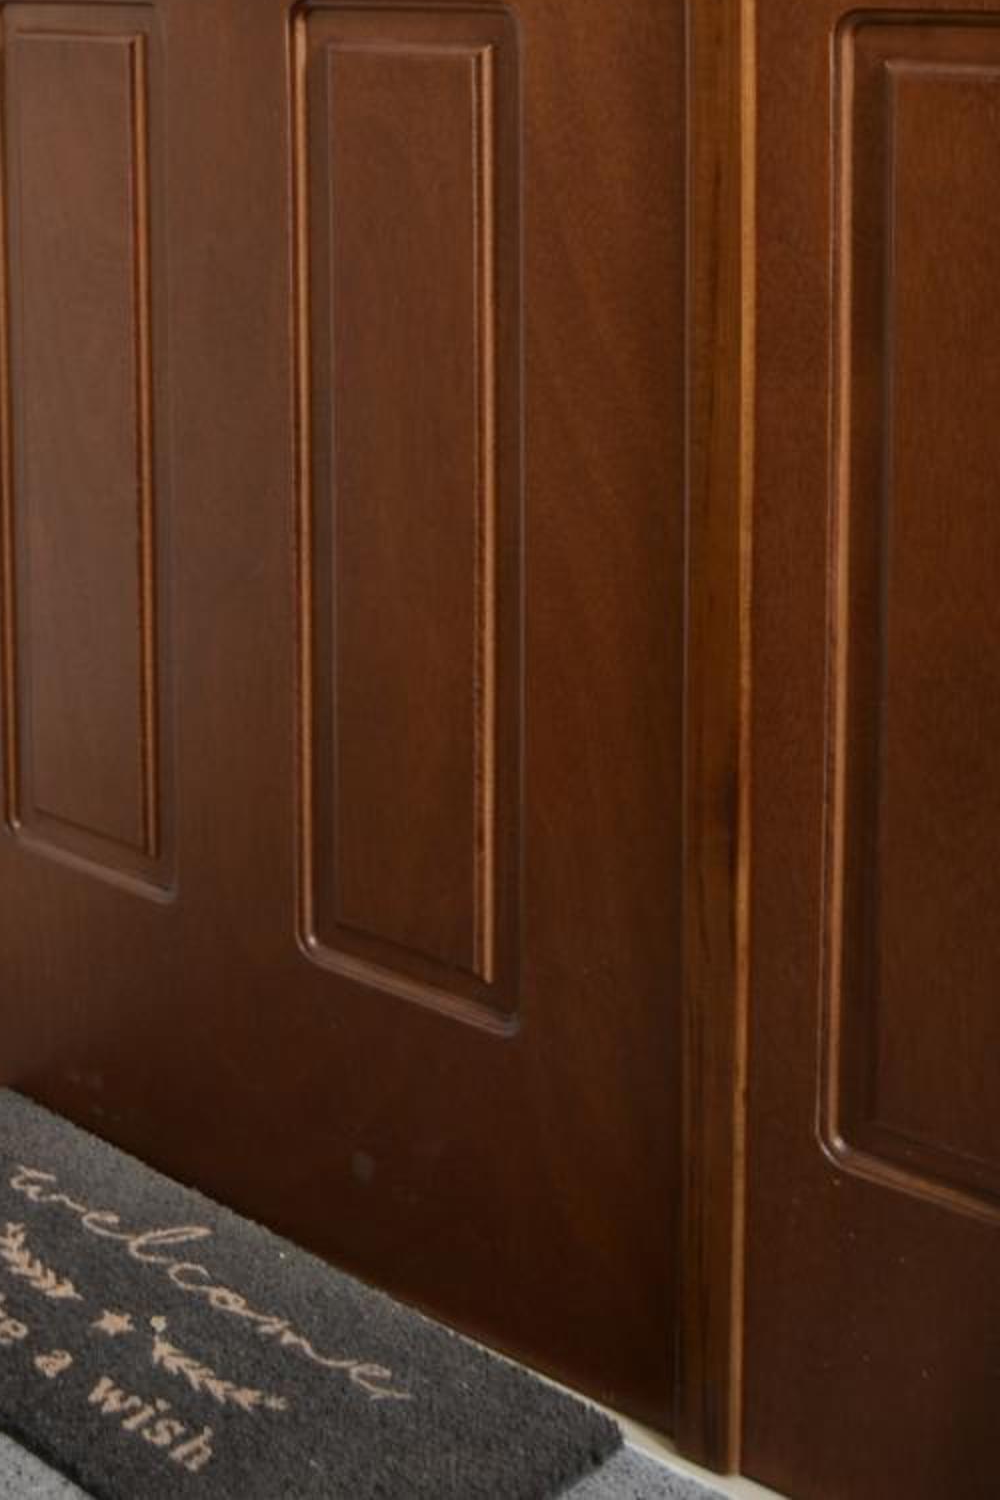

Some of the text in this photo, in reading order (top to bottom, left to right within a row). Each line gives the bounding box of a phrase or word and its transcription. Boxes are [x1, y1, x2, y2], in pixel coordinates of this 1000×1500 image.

[11, 1165, 412, 1400] welcome
[34, 1348, 73, 1378] a
[87, 1376, 215, 1472] wish
